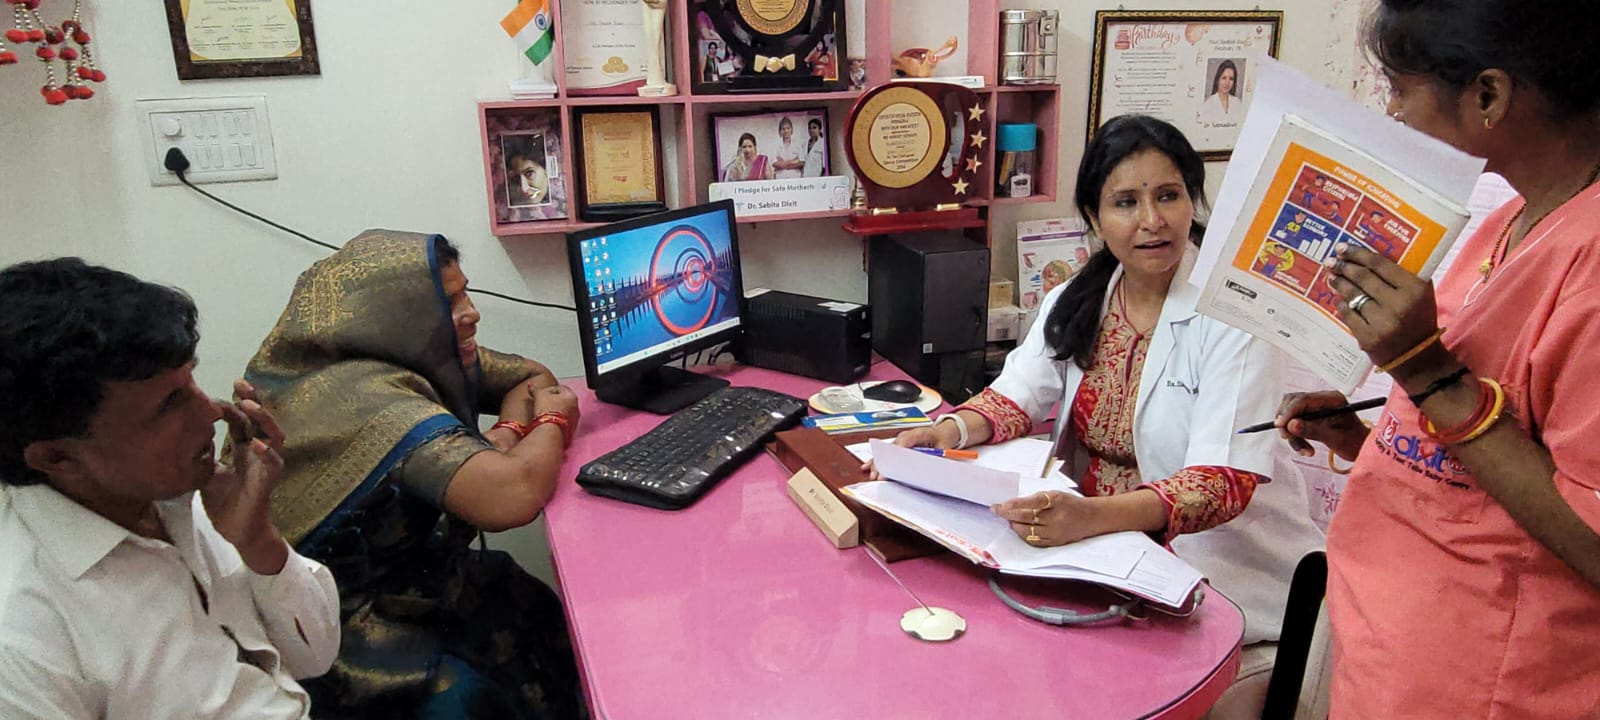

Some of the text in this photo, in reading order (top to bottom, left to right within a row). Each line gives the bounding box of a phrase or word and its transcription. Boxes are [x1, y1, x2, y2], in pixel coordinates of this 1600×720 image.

[1333, 165, 1358, 184] POWER
[738, 187, 760, 195] Pledge
[787, 183, 827, 191] Motherhd
